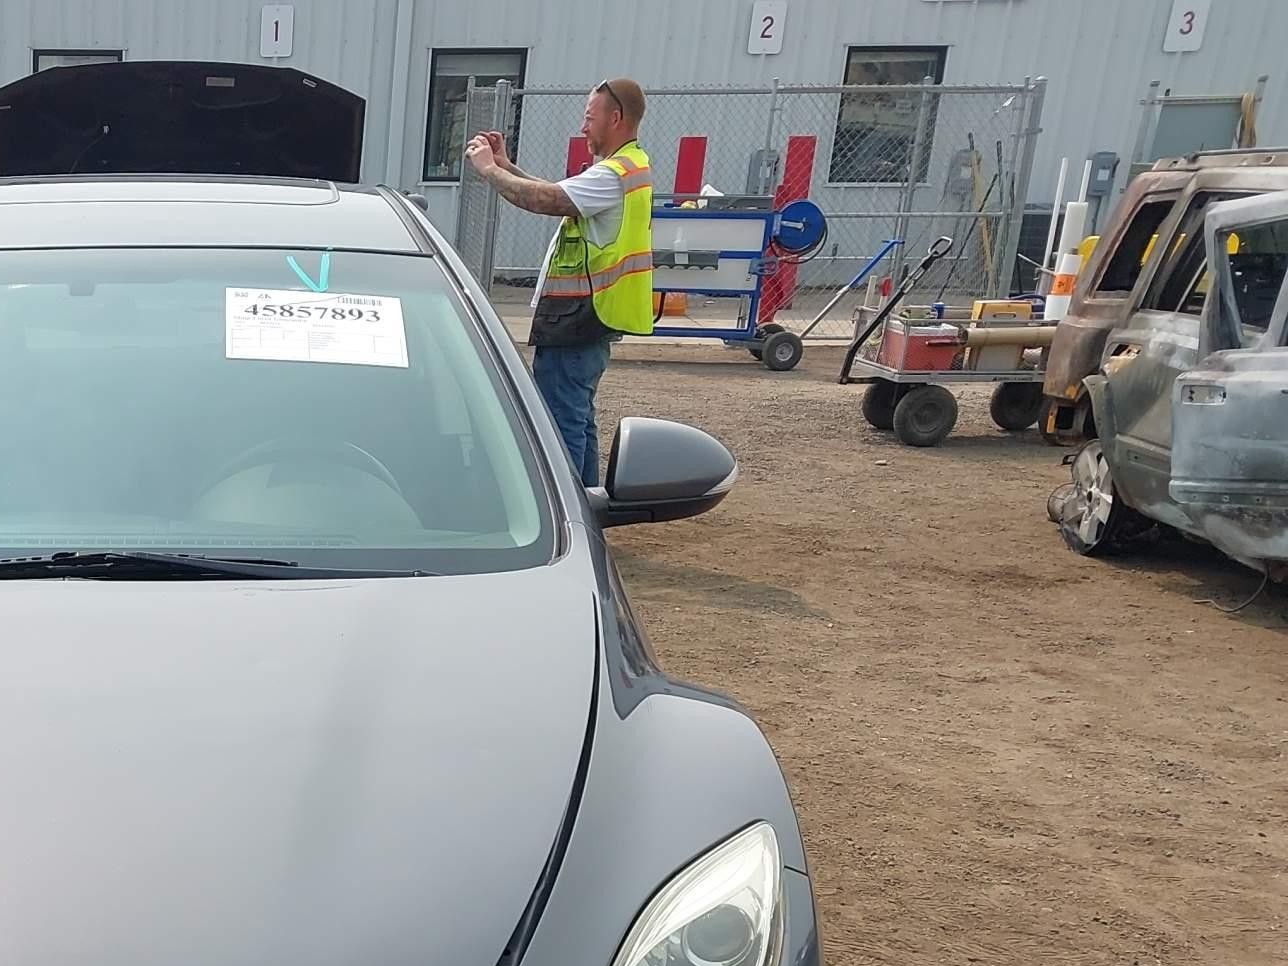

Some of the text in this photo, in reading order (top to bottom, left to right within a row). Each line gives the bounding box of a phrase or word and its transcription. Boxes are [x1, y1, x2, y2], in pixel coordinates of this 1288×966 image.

[273, 19, 280, 42] 1
[759, 15, 774, 39] 2
[1179, 10, 1195, 35] 3
[244, 303, 381, 323] 45857893
